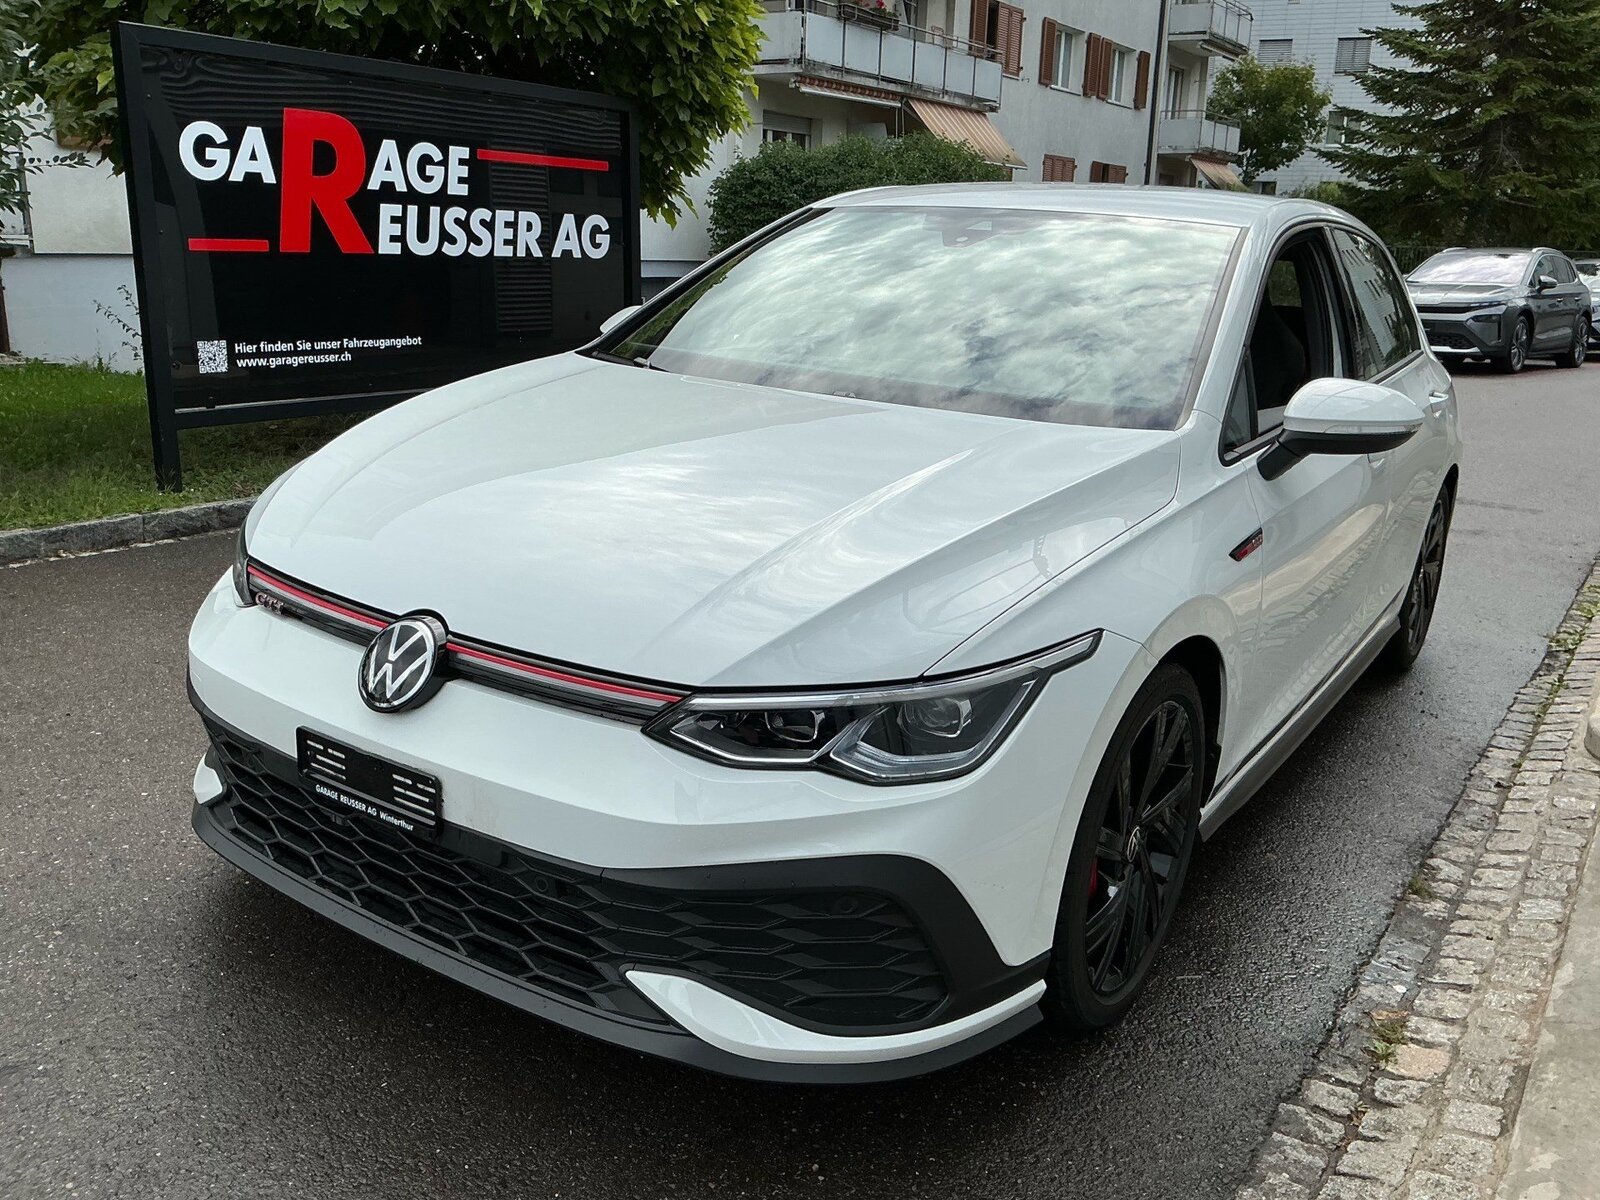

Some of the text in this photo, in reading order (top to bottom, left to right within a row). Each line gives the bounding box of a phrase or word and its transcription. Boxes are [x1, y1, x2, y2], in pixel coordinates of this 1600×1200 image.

[179, 107, 471, 253] GARAGE
[551, 213, 611, 260] AG
[235, 336, 422, 354] Hier finden Sie unser Fahrzeugangebot
[236, 351, 352, 368] www.garagereusser.ch
[315, 784, 414, 831] GARAGE REUSSER AG Winterthur
